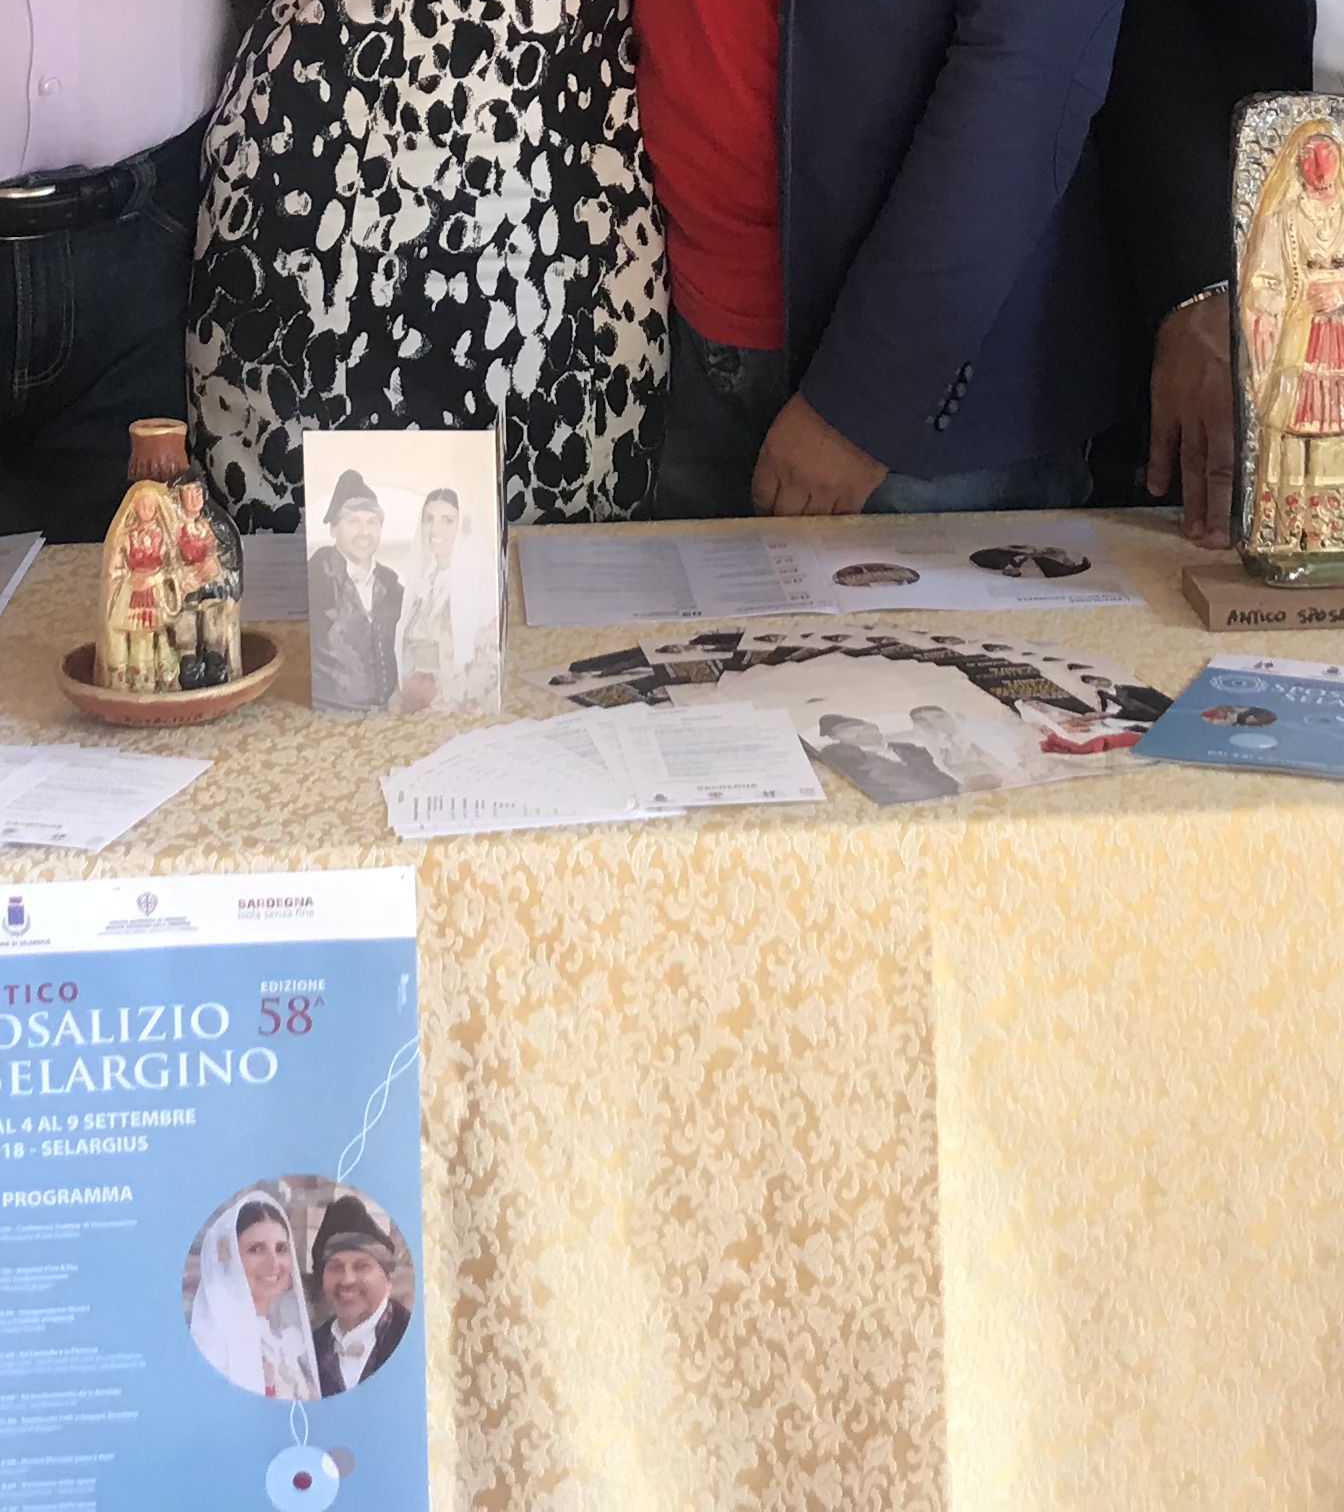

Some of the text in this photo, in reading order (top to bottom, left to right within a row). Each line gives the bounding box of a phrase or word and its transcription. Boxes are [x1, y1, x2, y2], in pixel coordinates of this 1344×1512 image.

[238, 896, 314, 909] SARDEGNA
[260, 979, 326, 992] EDIZIONE
[21, 1116, 32, 1133] 4
[37, 1114, 62, 1132] AL
[67, 1113, 78, 1131] 9
[84, 1108, 197, 1130] SETTEMBRE
[41, 1136, 149, 1156] SELARGIUS
[3, 1185, 133, 1208] PROGRAMMA
